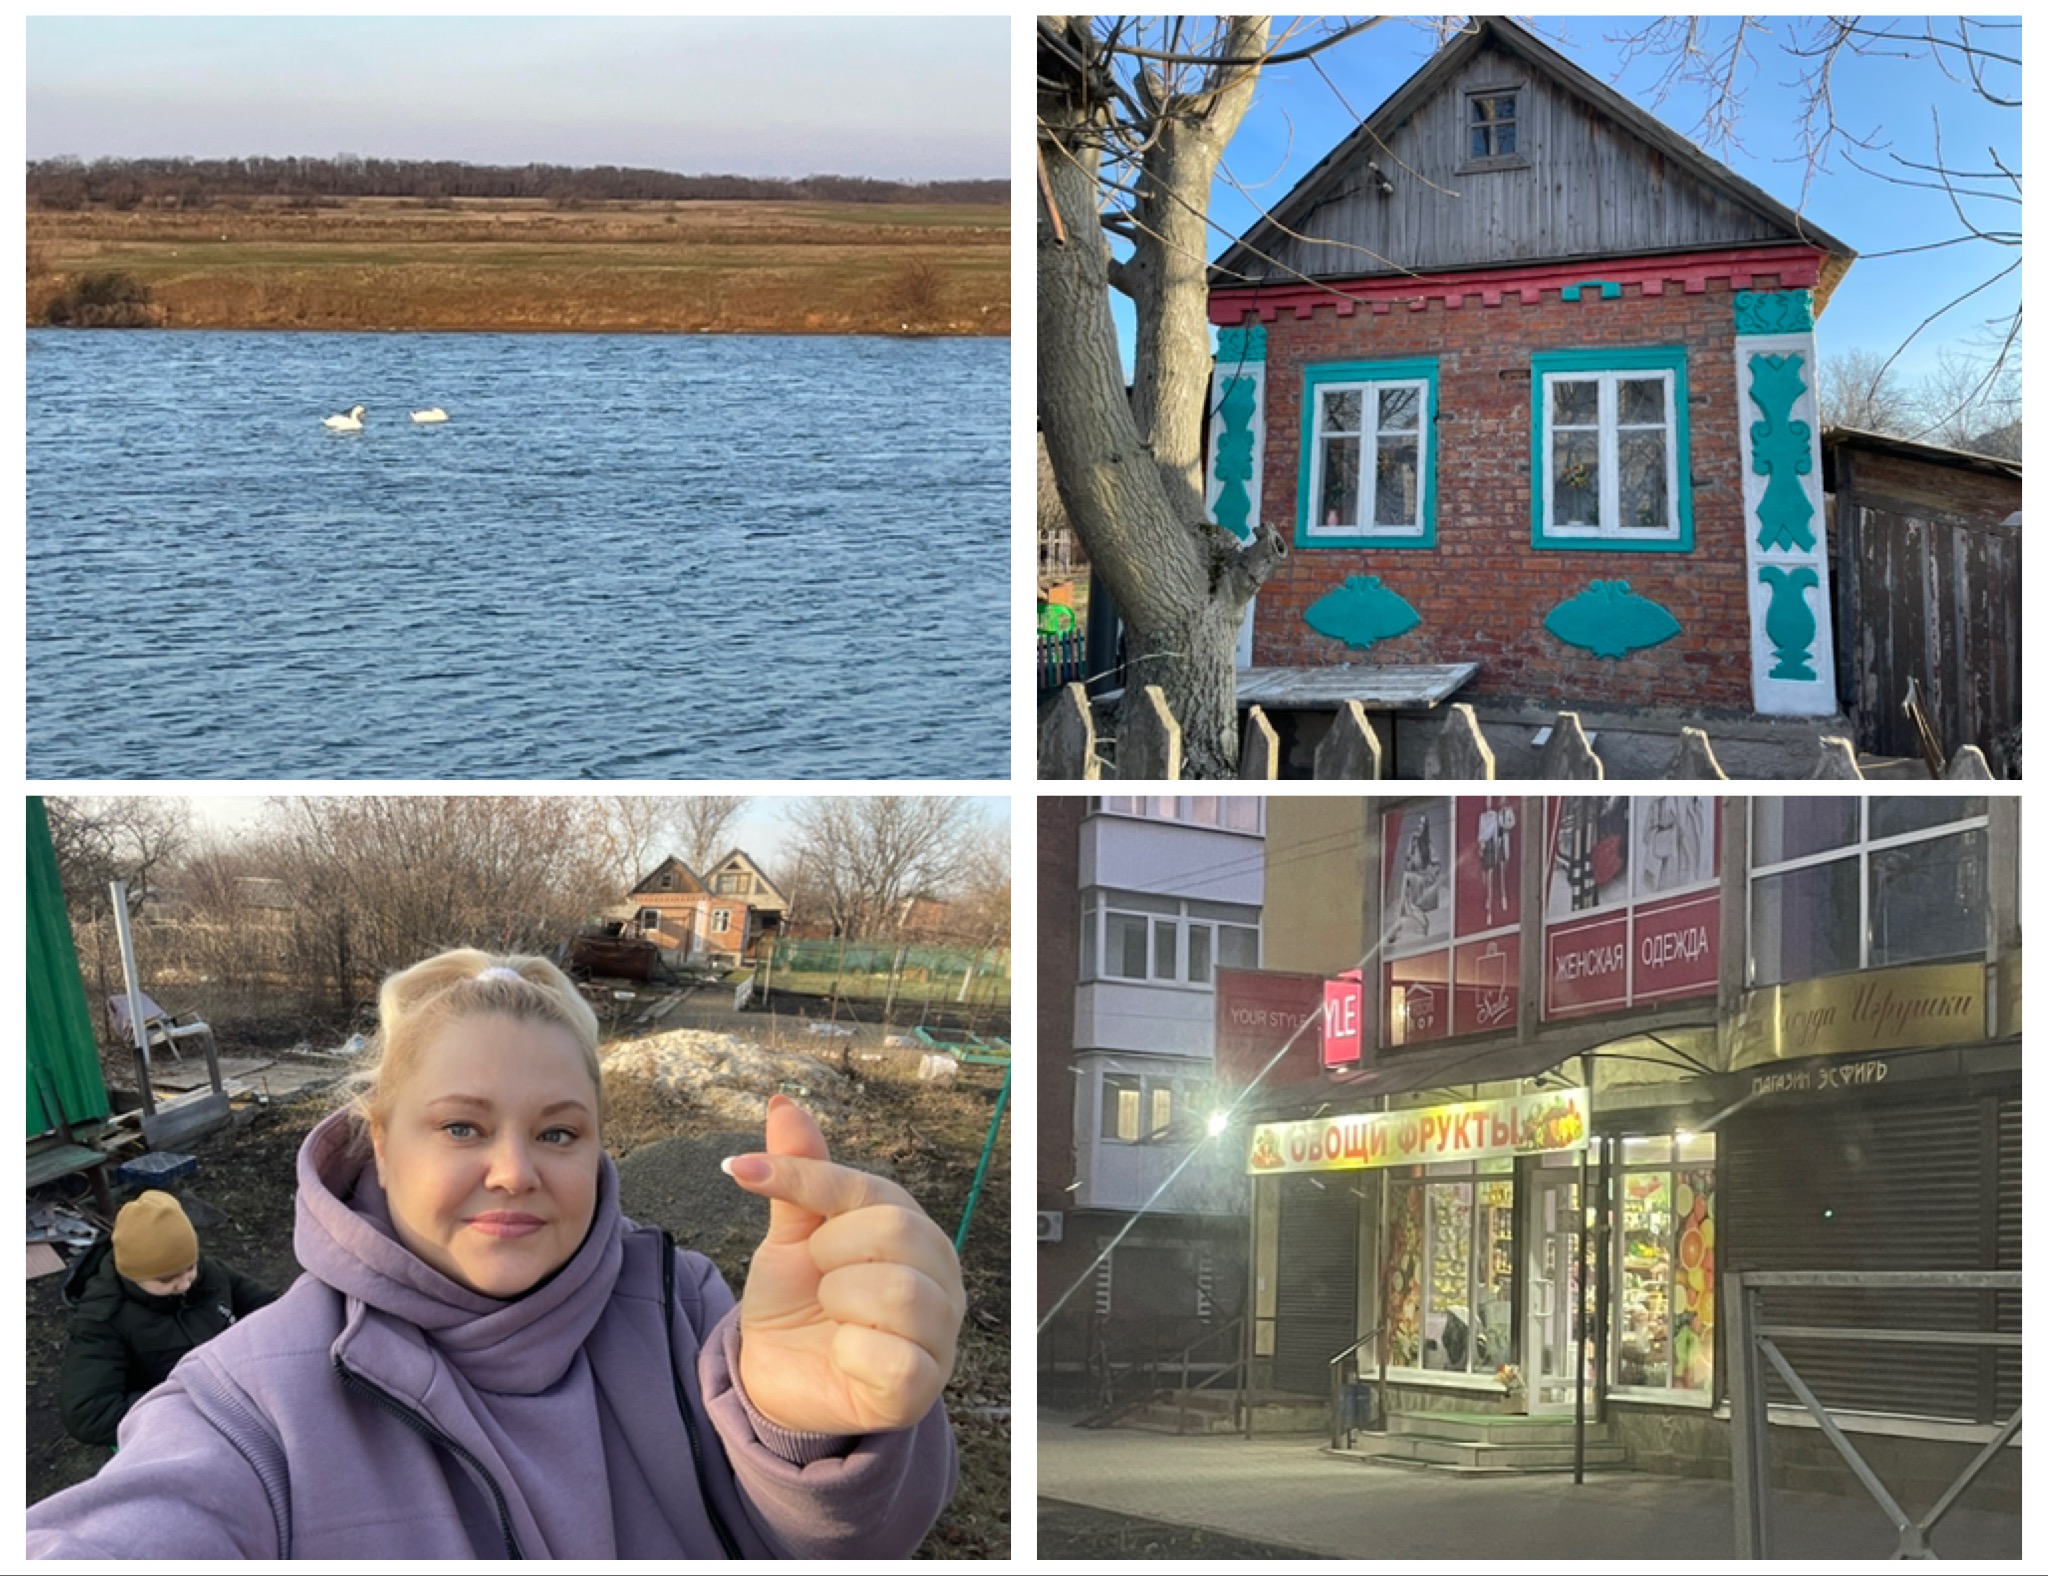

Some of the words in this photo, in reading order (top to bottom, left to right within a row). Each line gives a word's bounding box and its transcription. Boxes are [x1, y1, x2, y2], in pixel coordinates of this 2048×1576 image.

[1556, 944, 1624, 981] ЖЕНСКАЯ
[1641, 926, 1709, 970] ОДЕЖДА
[1229, 1007, 1267, 1026] YOUR
[1818, 1060, 1888, 1091] ЭСФИРЬ
[1290, 1121, 1389, 1164] ОВОЩИ
[1396, 1107, 1518, 1156] ФРУКТЫ
